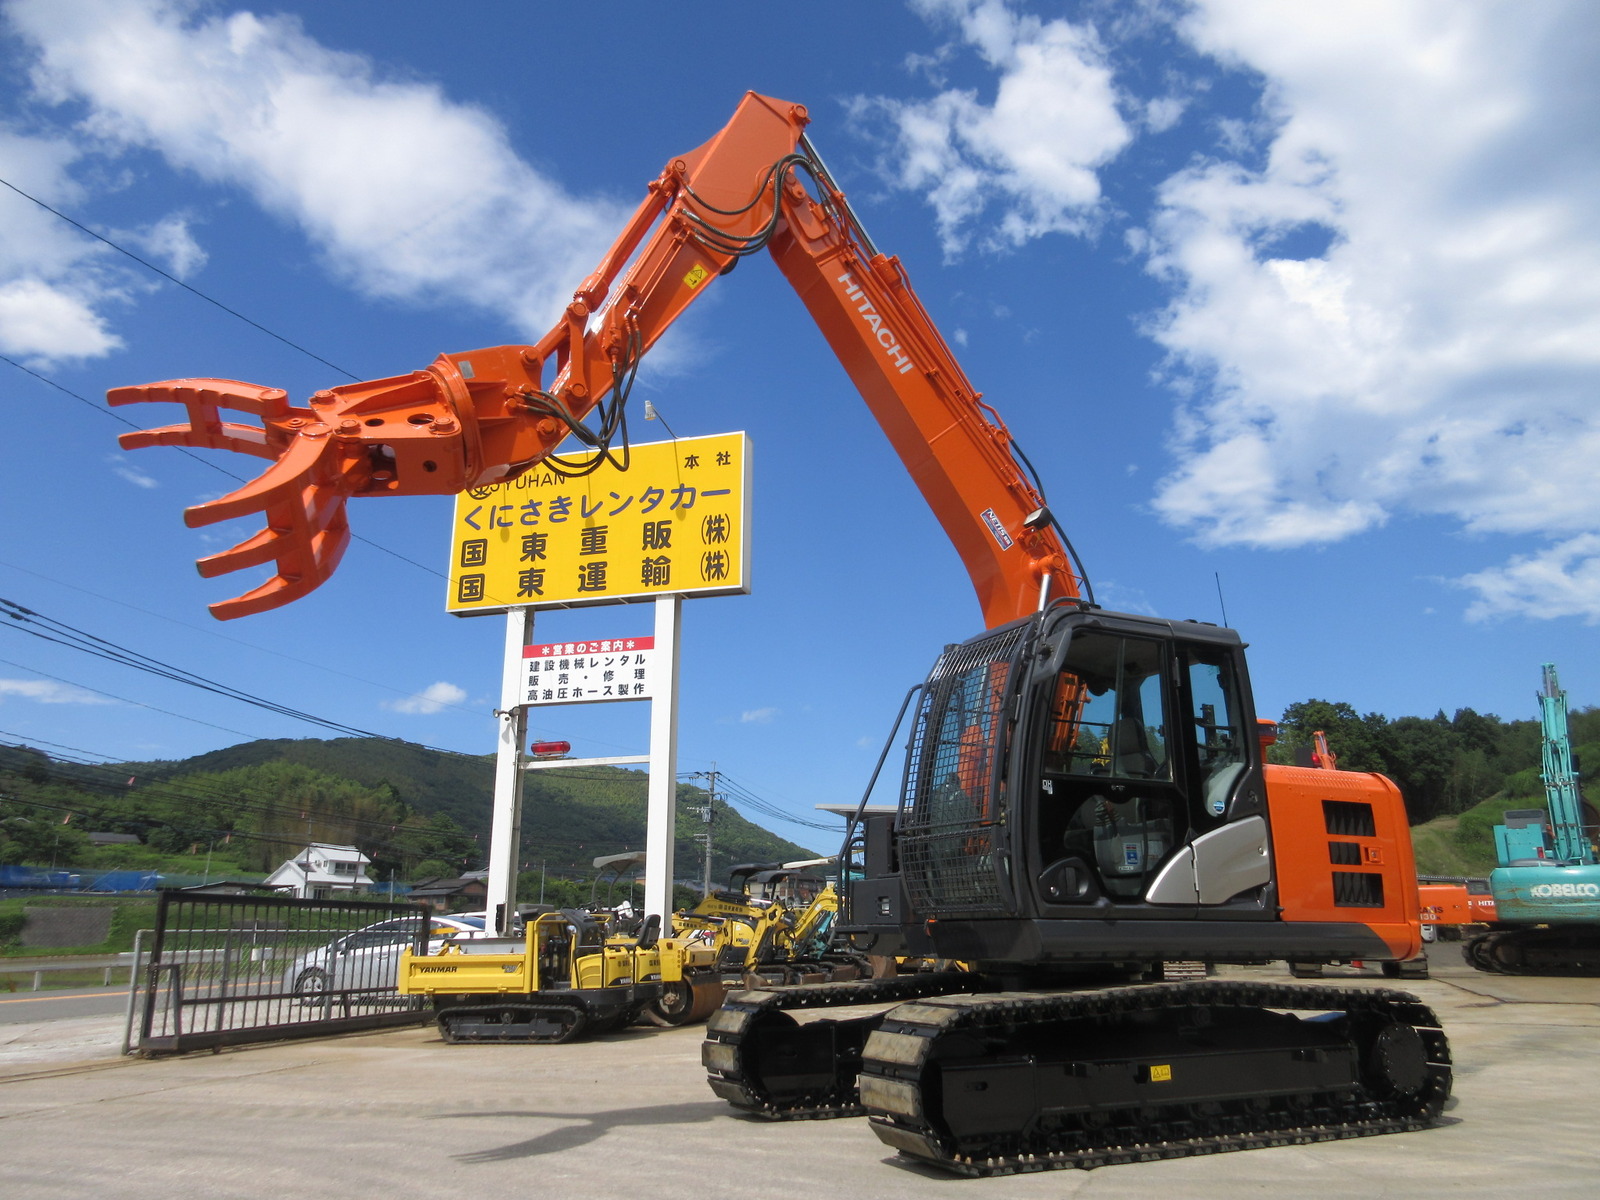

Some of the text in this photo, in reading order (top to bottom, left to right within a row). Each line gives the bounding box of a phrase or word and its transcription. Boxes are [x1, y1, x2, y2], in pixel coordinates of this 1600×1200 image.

[837, 272, 914, 374] HITACHI
[684, 451, 731, 470] 本社
[464, 483, 731, 531] くにさきレンタカー
[529, 654, 646, 673] 建設機械レンタル
[527, 683, 645, 701] 高油圧ホース製作
[1530, 883, 1600, 897] KOBELCO
